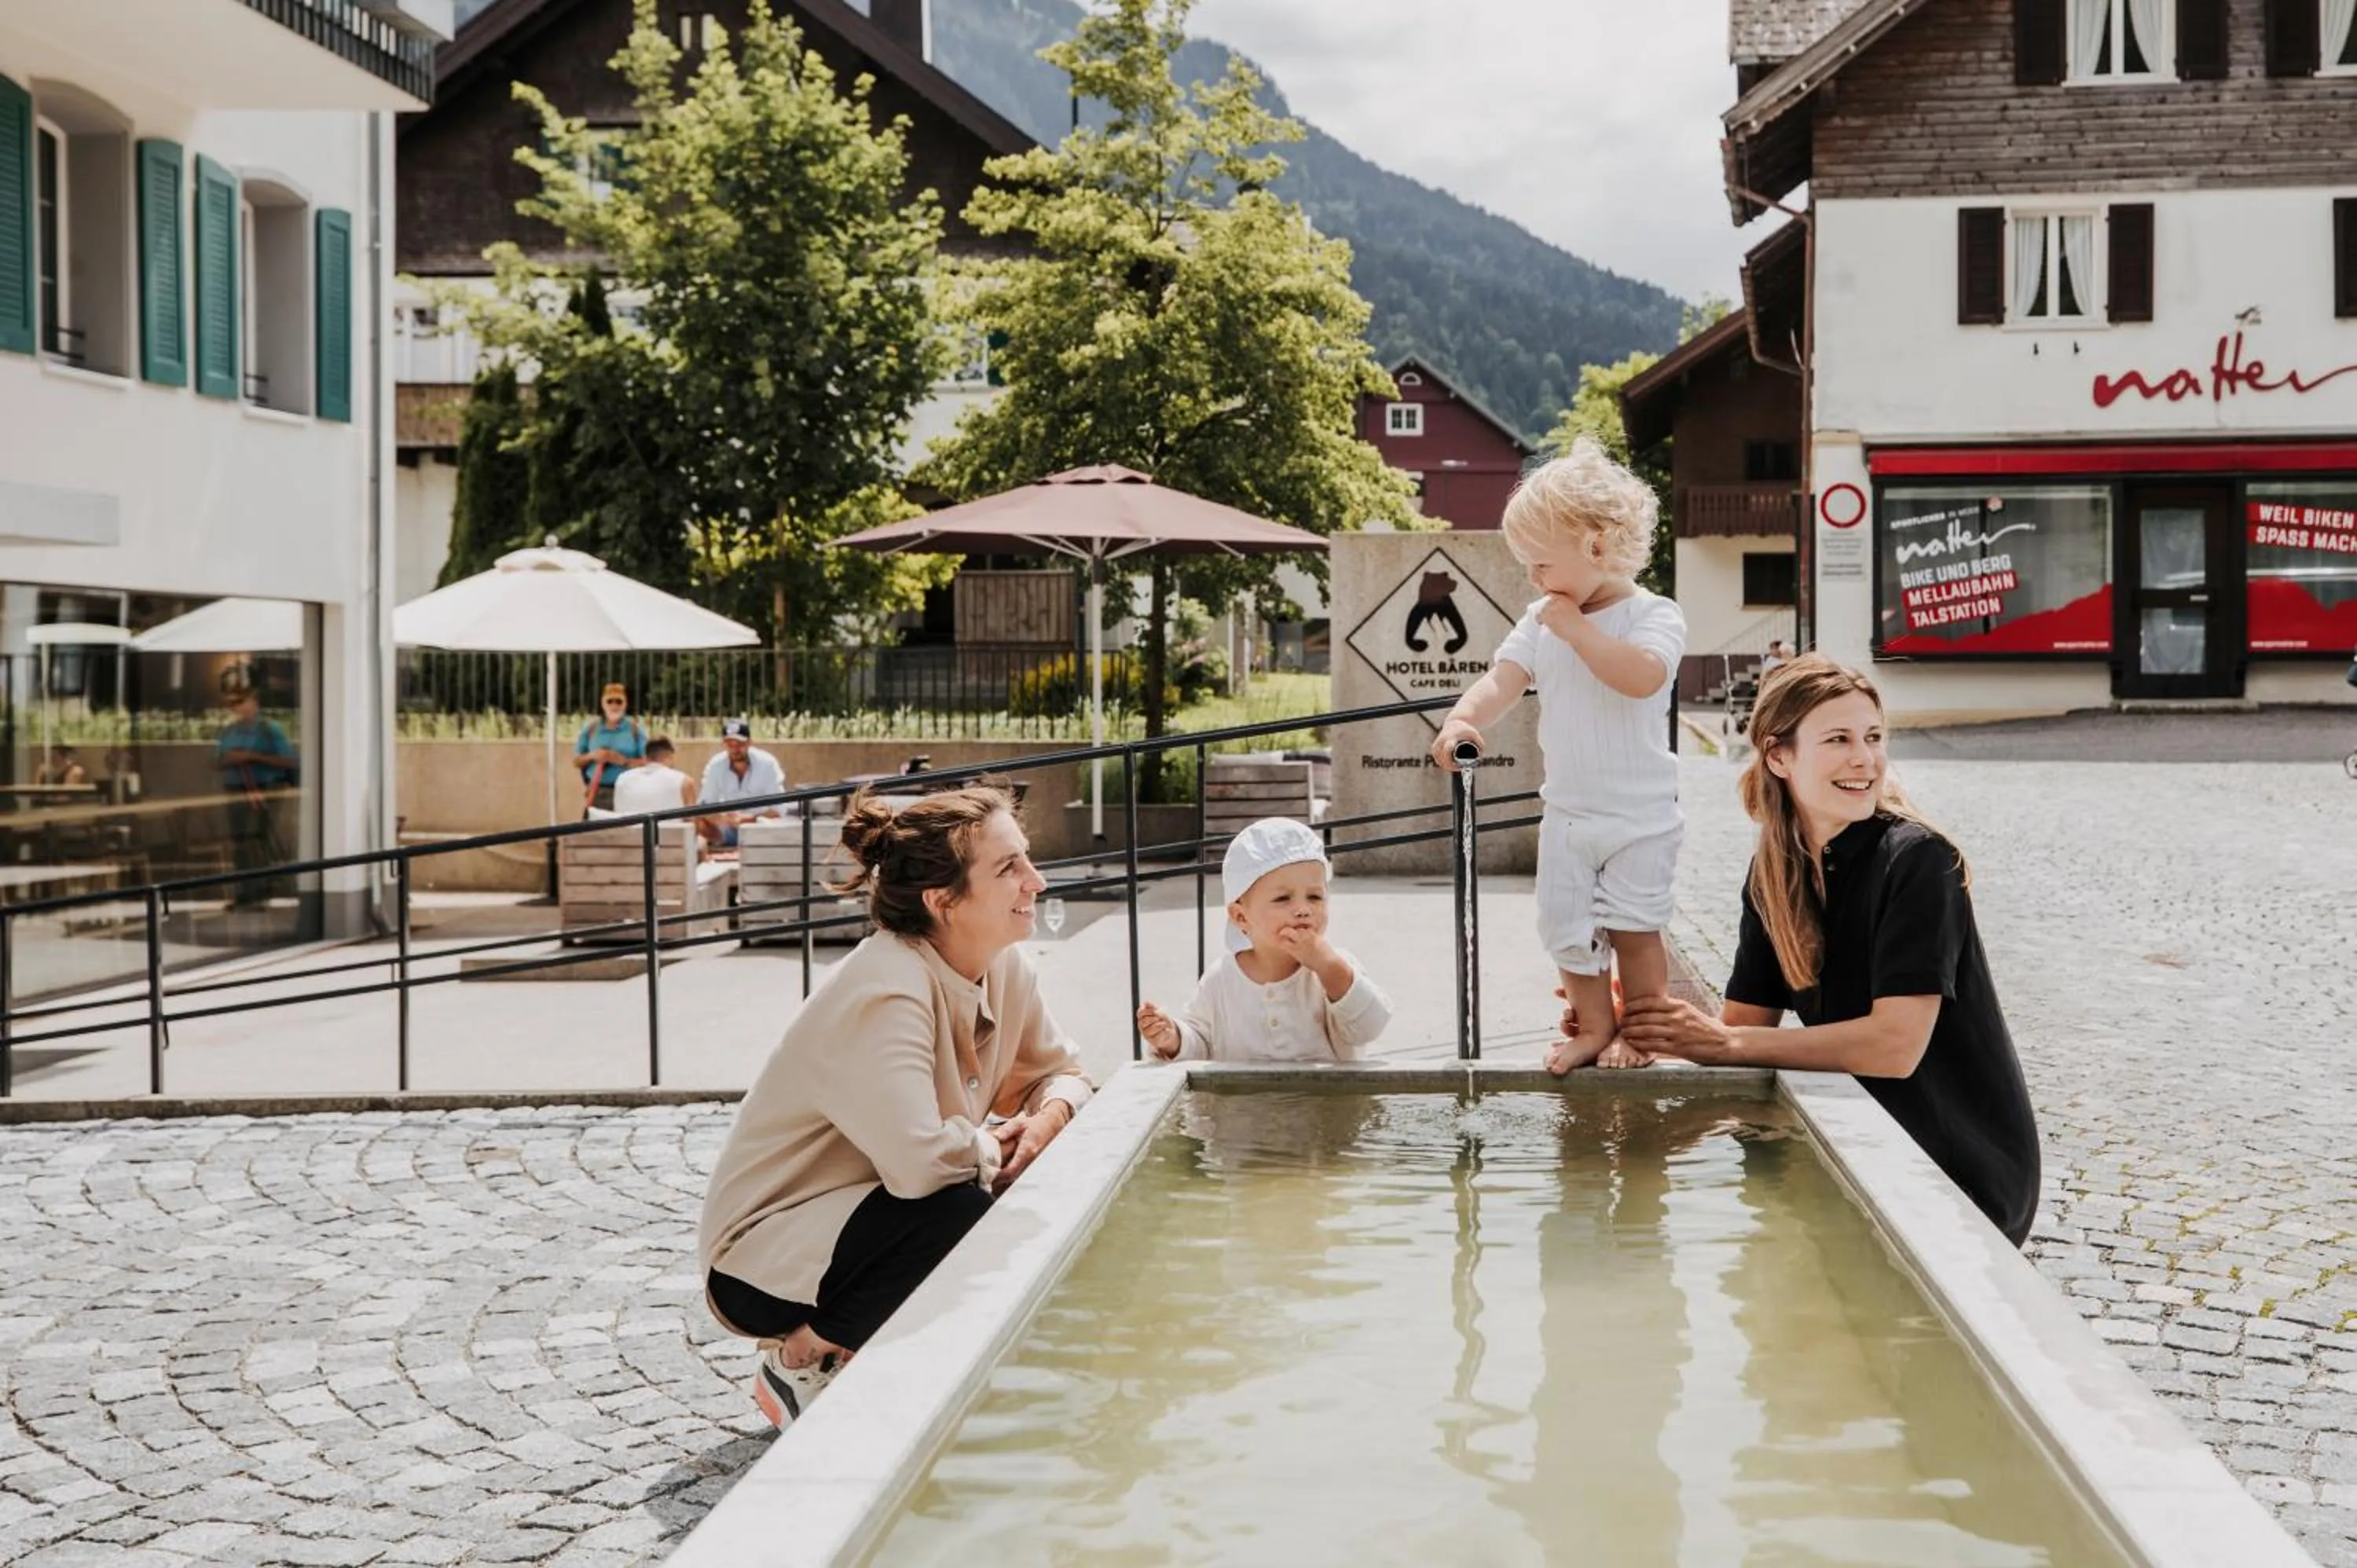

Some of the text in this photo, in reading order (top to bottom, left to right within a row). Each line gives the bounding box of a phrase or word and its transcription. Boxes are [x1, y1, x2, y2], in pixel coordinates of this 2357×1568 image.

[2260, 504, 2355, 529] WEIL BIKEN
[2256, 526, 2309, 548] SPASS
[1900, 554, 2013, 588] BIKE UND BERG
[1908, 571, 2015, 607] MELLAUBAHN
[1911, 597, 2001, 628] TALSTATION
[1386, 658, 1489, 675] HOTEL BÄREN
[1438, 678, 1461, 688] DELI
[1362, 754, 1422, 769] Ristorante
